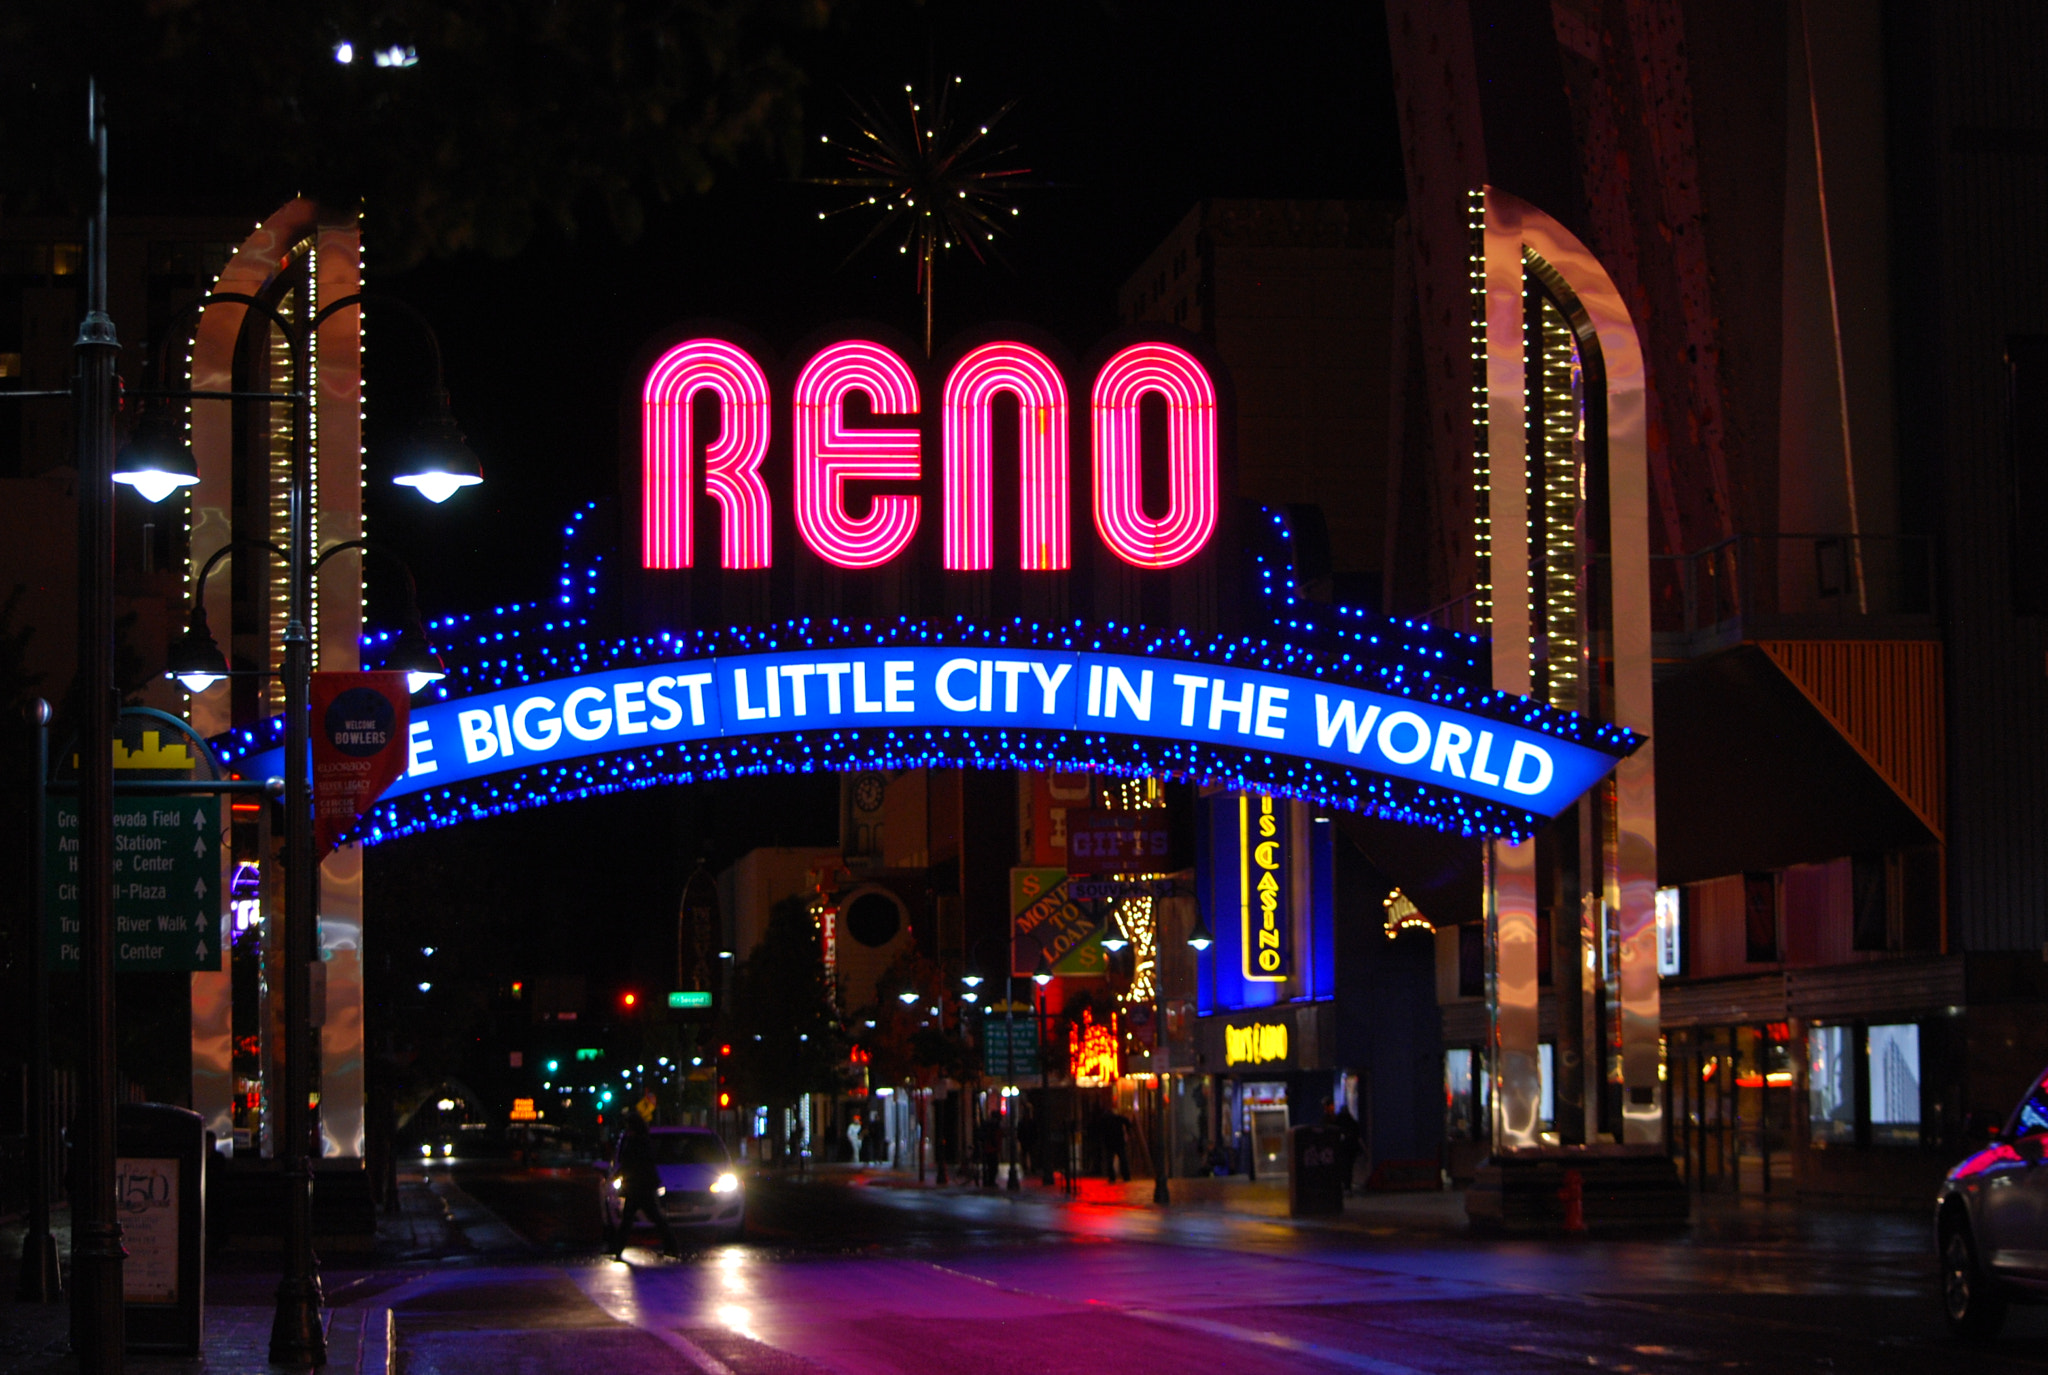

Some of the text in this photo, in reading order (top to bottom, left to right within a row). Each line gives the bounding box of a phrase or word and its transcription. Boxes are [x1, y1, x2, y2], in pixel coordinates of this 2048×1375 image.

[642, 337, 1220, 571] RENO
[345, 720, 376, 730] WELCOME
[458, 676, 713, 764] BIGGEST
[734, 660, 915, 721] LITTLE
[935, 658, 1073, 714] CITY
[1087, 664, 1154, 721] IN
[1173, 673, 1290, 739] THE
[1315, 693, 1554, 795] WORLD
[335, 731, 386, 744] BOWLERS
[57, 810, 181, 828] Gre evada Field
[133, 855, 174, 872] Center
[58, 884, 80, 900] Cit
[117, 915, 187, 932] River Walk
[1048, 903, 1080, 930] TO
[1042, 919, 1096, 965] LOAN
[120, 944, 164, 960] Center
